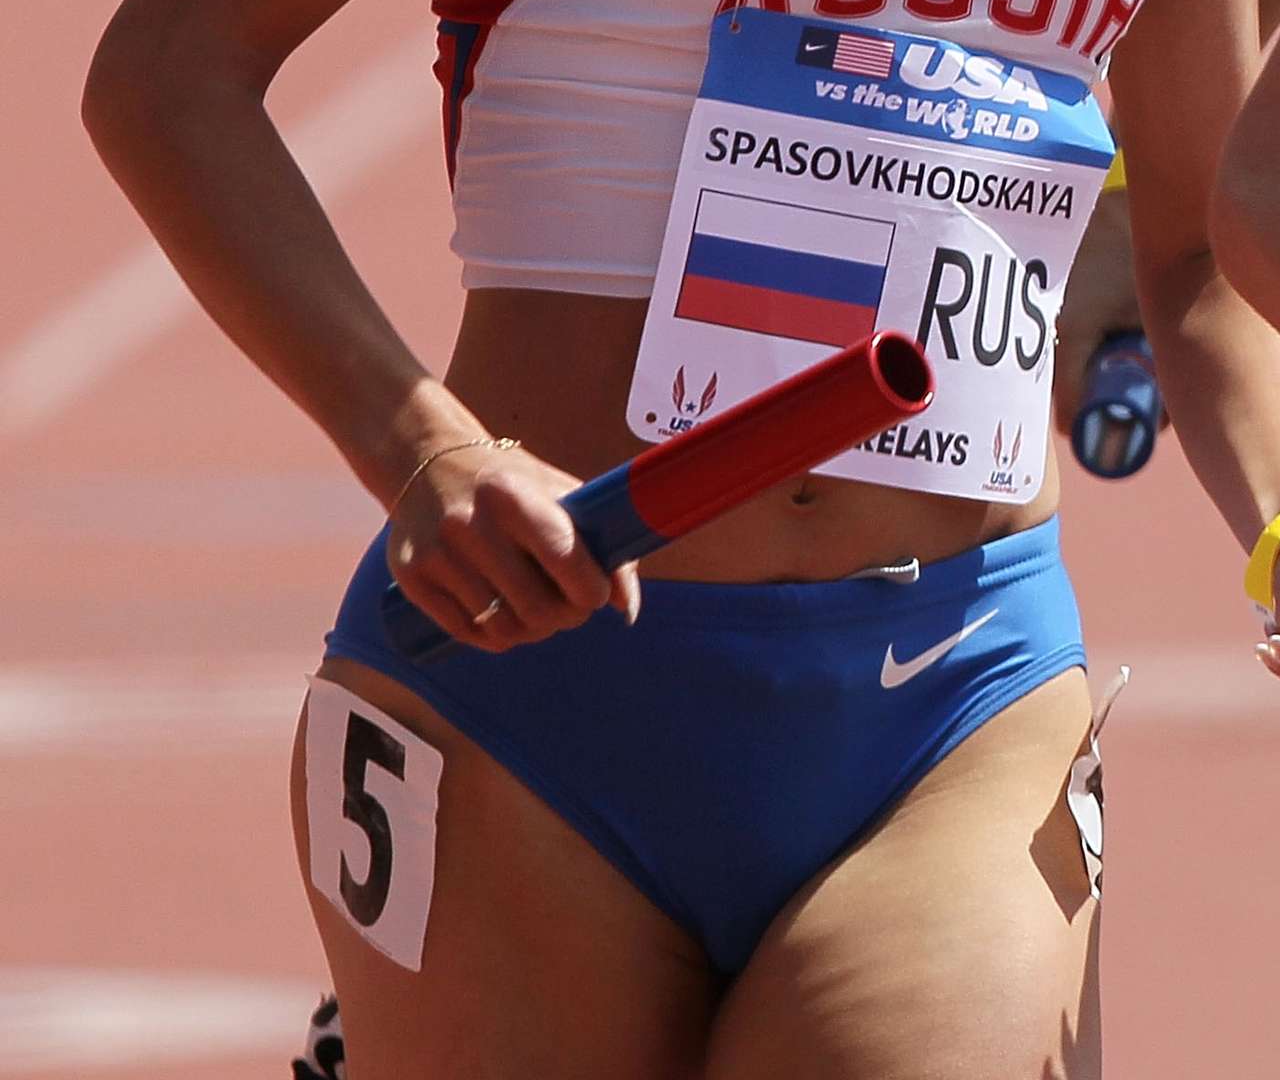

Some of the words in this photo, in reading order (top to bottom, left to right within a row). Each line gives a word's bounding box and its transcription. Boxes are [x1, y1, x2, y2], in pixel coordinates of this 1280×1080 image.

[814, 79, 849, 102] vs
[851, 82, 904, 111] the
[898, 43, 1049, 112] USA
[704, 126, 1075, 220] SPASOVKHODSKAYA
[915, 246, 1049, 371] RUS
[668, 416, 700, 432] US
[989, 471, 1014, 487] USA
[338, 709, 407, 928] 5
